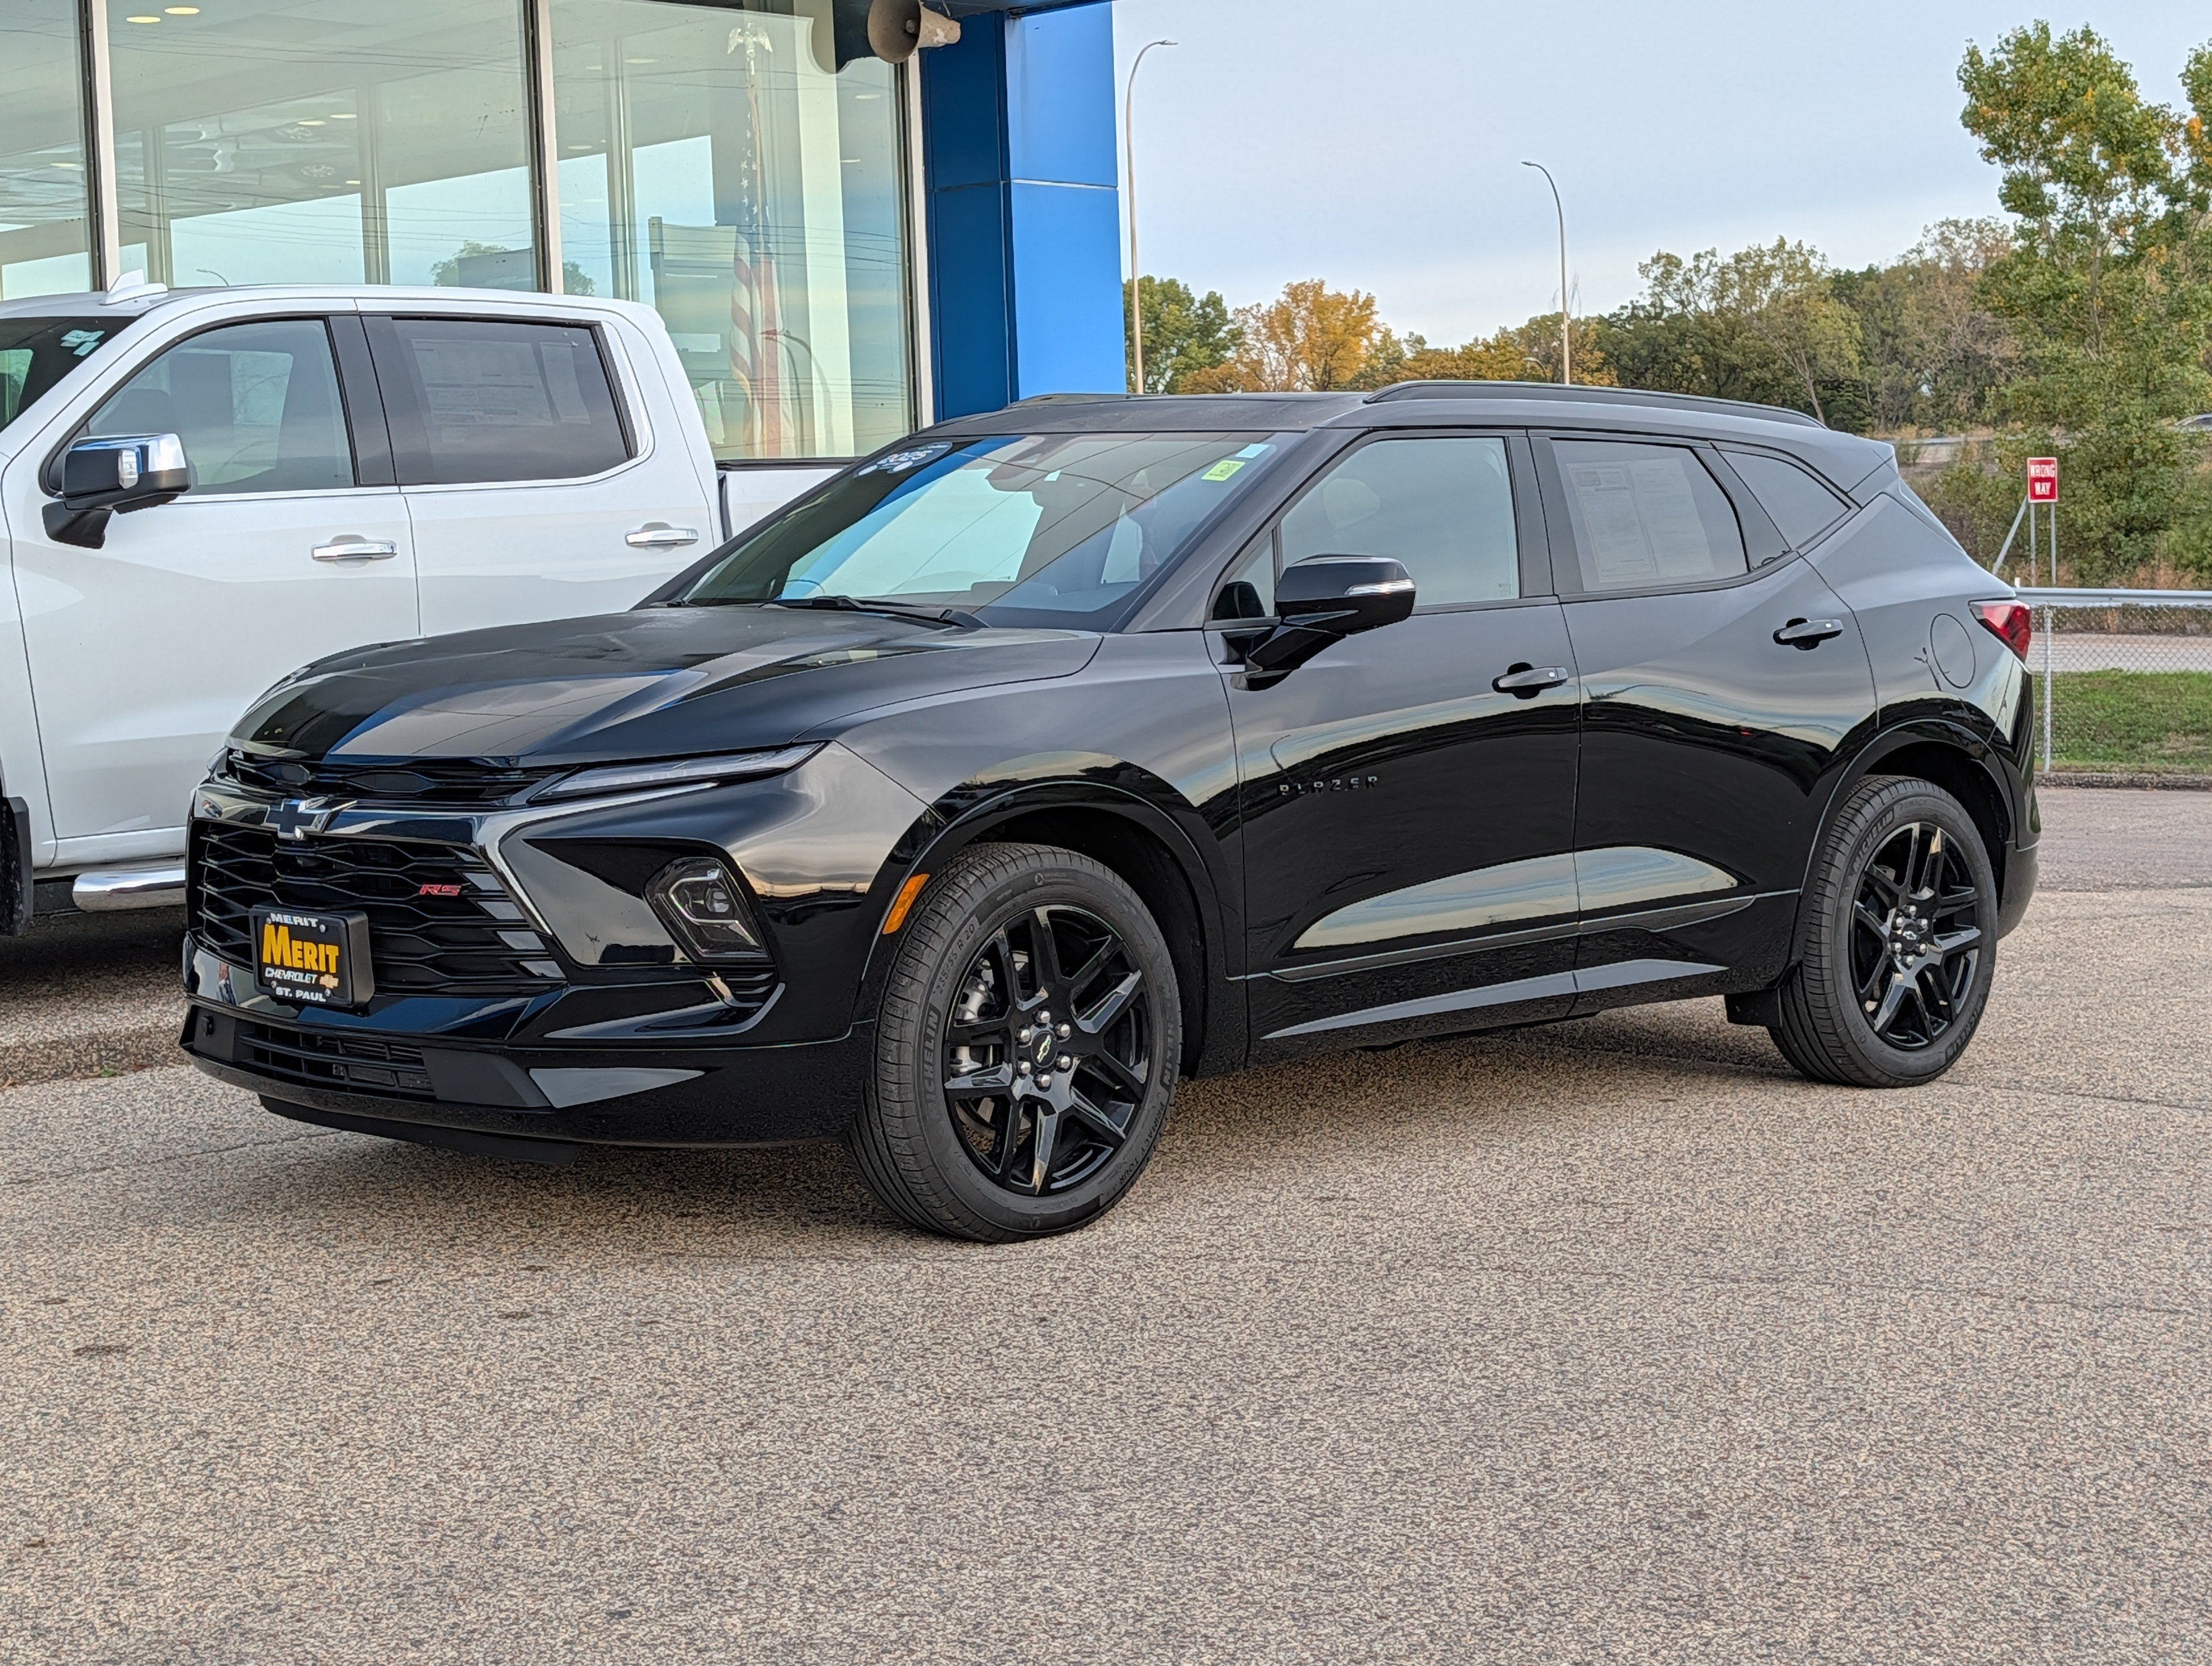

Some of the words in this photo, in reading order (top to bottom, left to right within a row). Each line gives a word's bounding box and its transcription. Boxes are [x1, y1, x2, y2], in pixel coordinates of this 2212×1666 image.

[2034, 482, 2052, 496] WAY
[419, 884, 462, 896] RS
[270, 912, 319, 928] MERIT
[262, 923, 339, 974] MERIT
[265, 967, 318, 984] CHEVROLET
[275, 986, 292, 997] ST.
[295, 990, 326, 1002] PAUL
